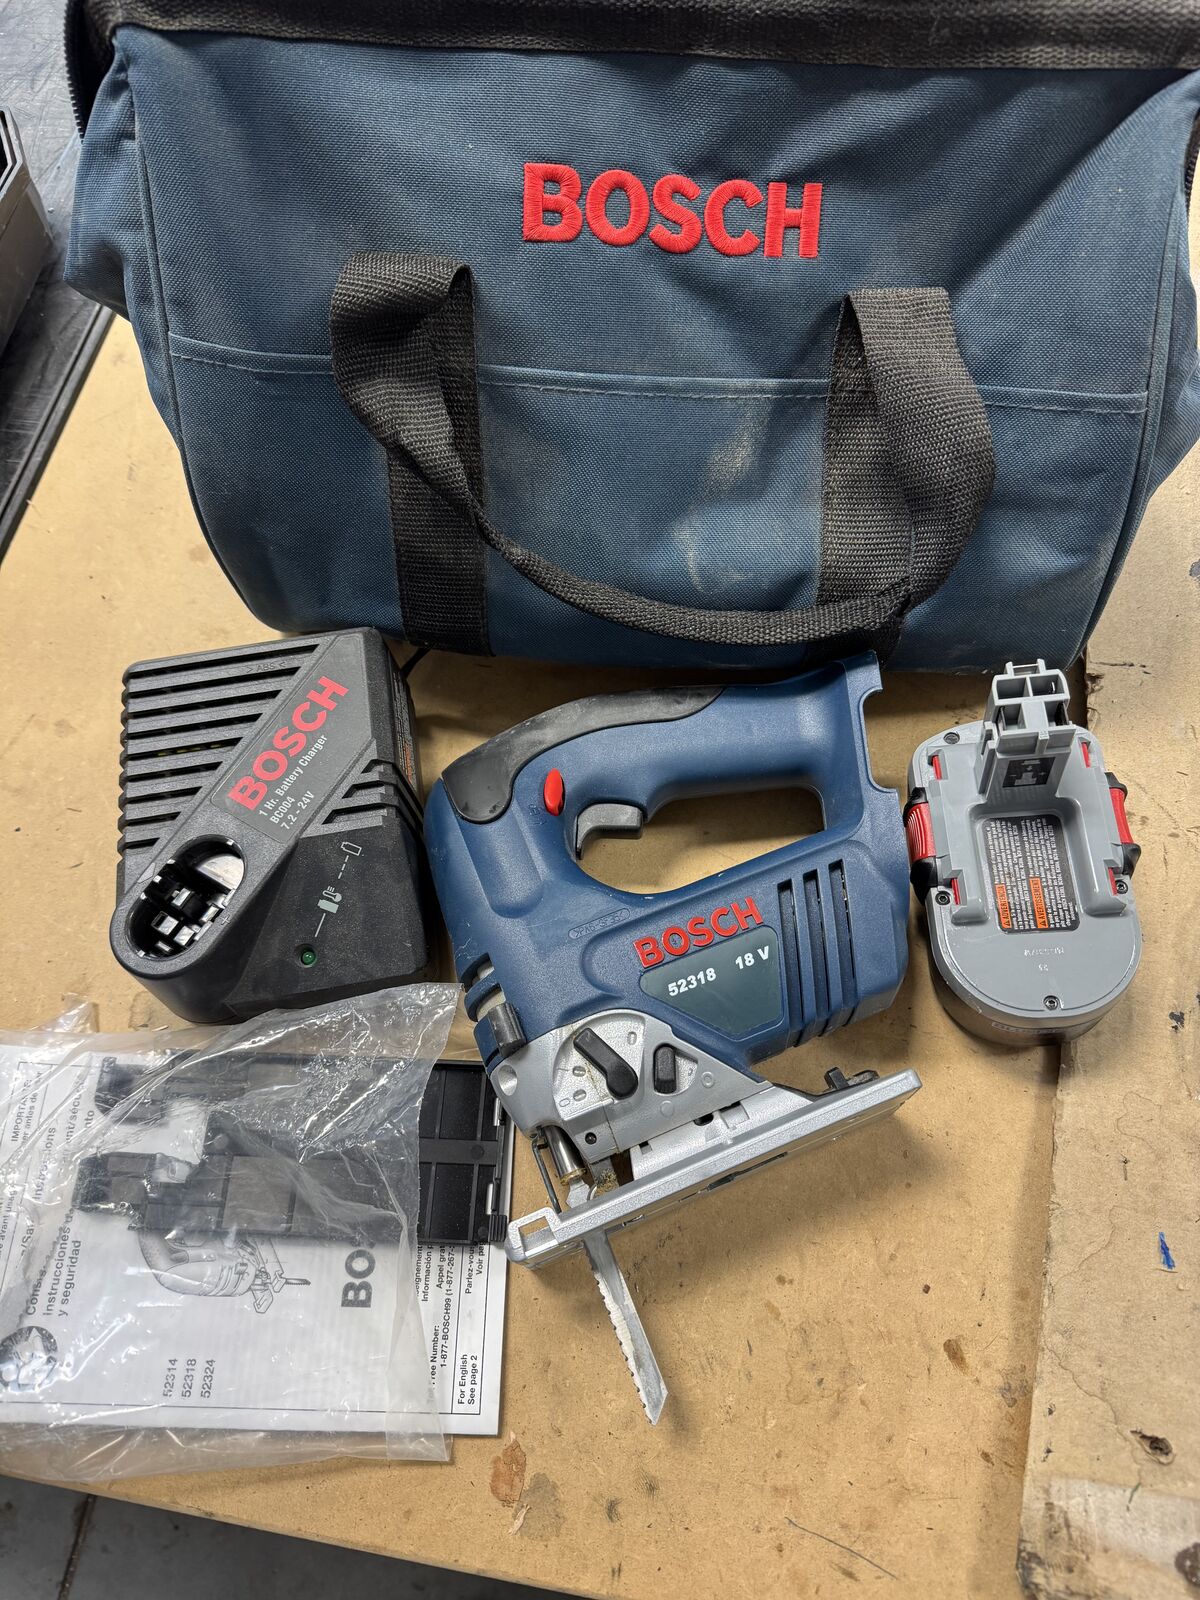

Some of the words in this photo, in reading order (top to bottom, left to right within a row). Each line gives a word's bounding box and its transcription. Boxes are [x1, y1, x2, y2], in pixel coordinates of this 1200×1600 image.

[523, 162, 823, 258] BOSCH
[227, 676, 349, 811] BOSCH
[258, 808, 268, 817] 1
[266, 794, 280, 812] Hr.
[275, 765, 305, 797] Battery
[299, 734, 329, 768] Charger
[269, 796, 296, 825] BC004
[280, 813, 298, 831] 7.2
[297, 790, 315, 811] 24V
[1032, 879, 1046, 919] AVERTISSEMENT
[633, 896, 765, 971] BOSCH
[667, 966, 718, 998] 52318
[735, 951, 756, 971] 18
[755, 946, 772, 963] V
[60, 1240, 81, 1304] seguridad
[422, 1251, 432, 1301] Información
[436, 1265, 445, 1289] Appel
[58, 1309, 68, 1317] y
[440, 1298, 452, 1367] 1-877-BOSCH99
[430, 1325, 439, 1362] Number:
[162, 1358, 178, 1398] 52314
[181, 1358, 197, 1398] 52318
[200, 1359, 216, 1399] 52324
[459, 1354, 468, 1386] English
[470, 1363, 478, 1385] page
